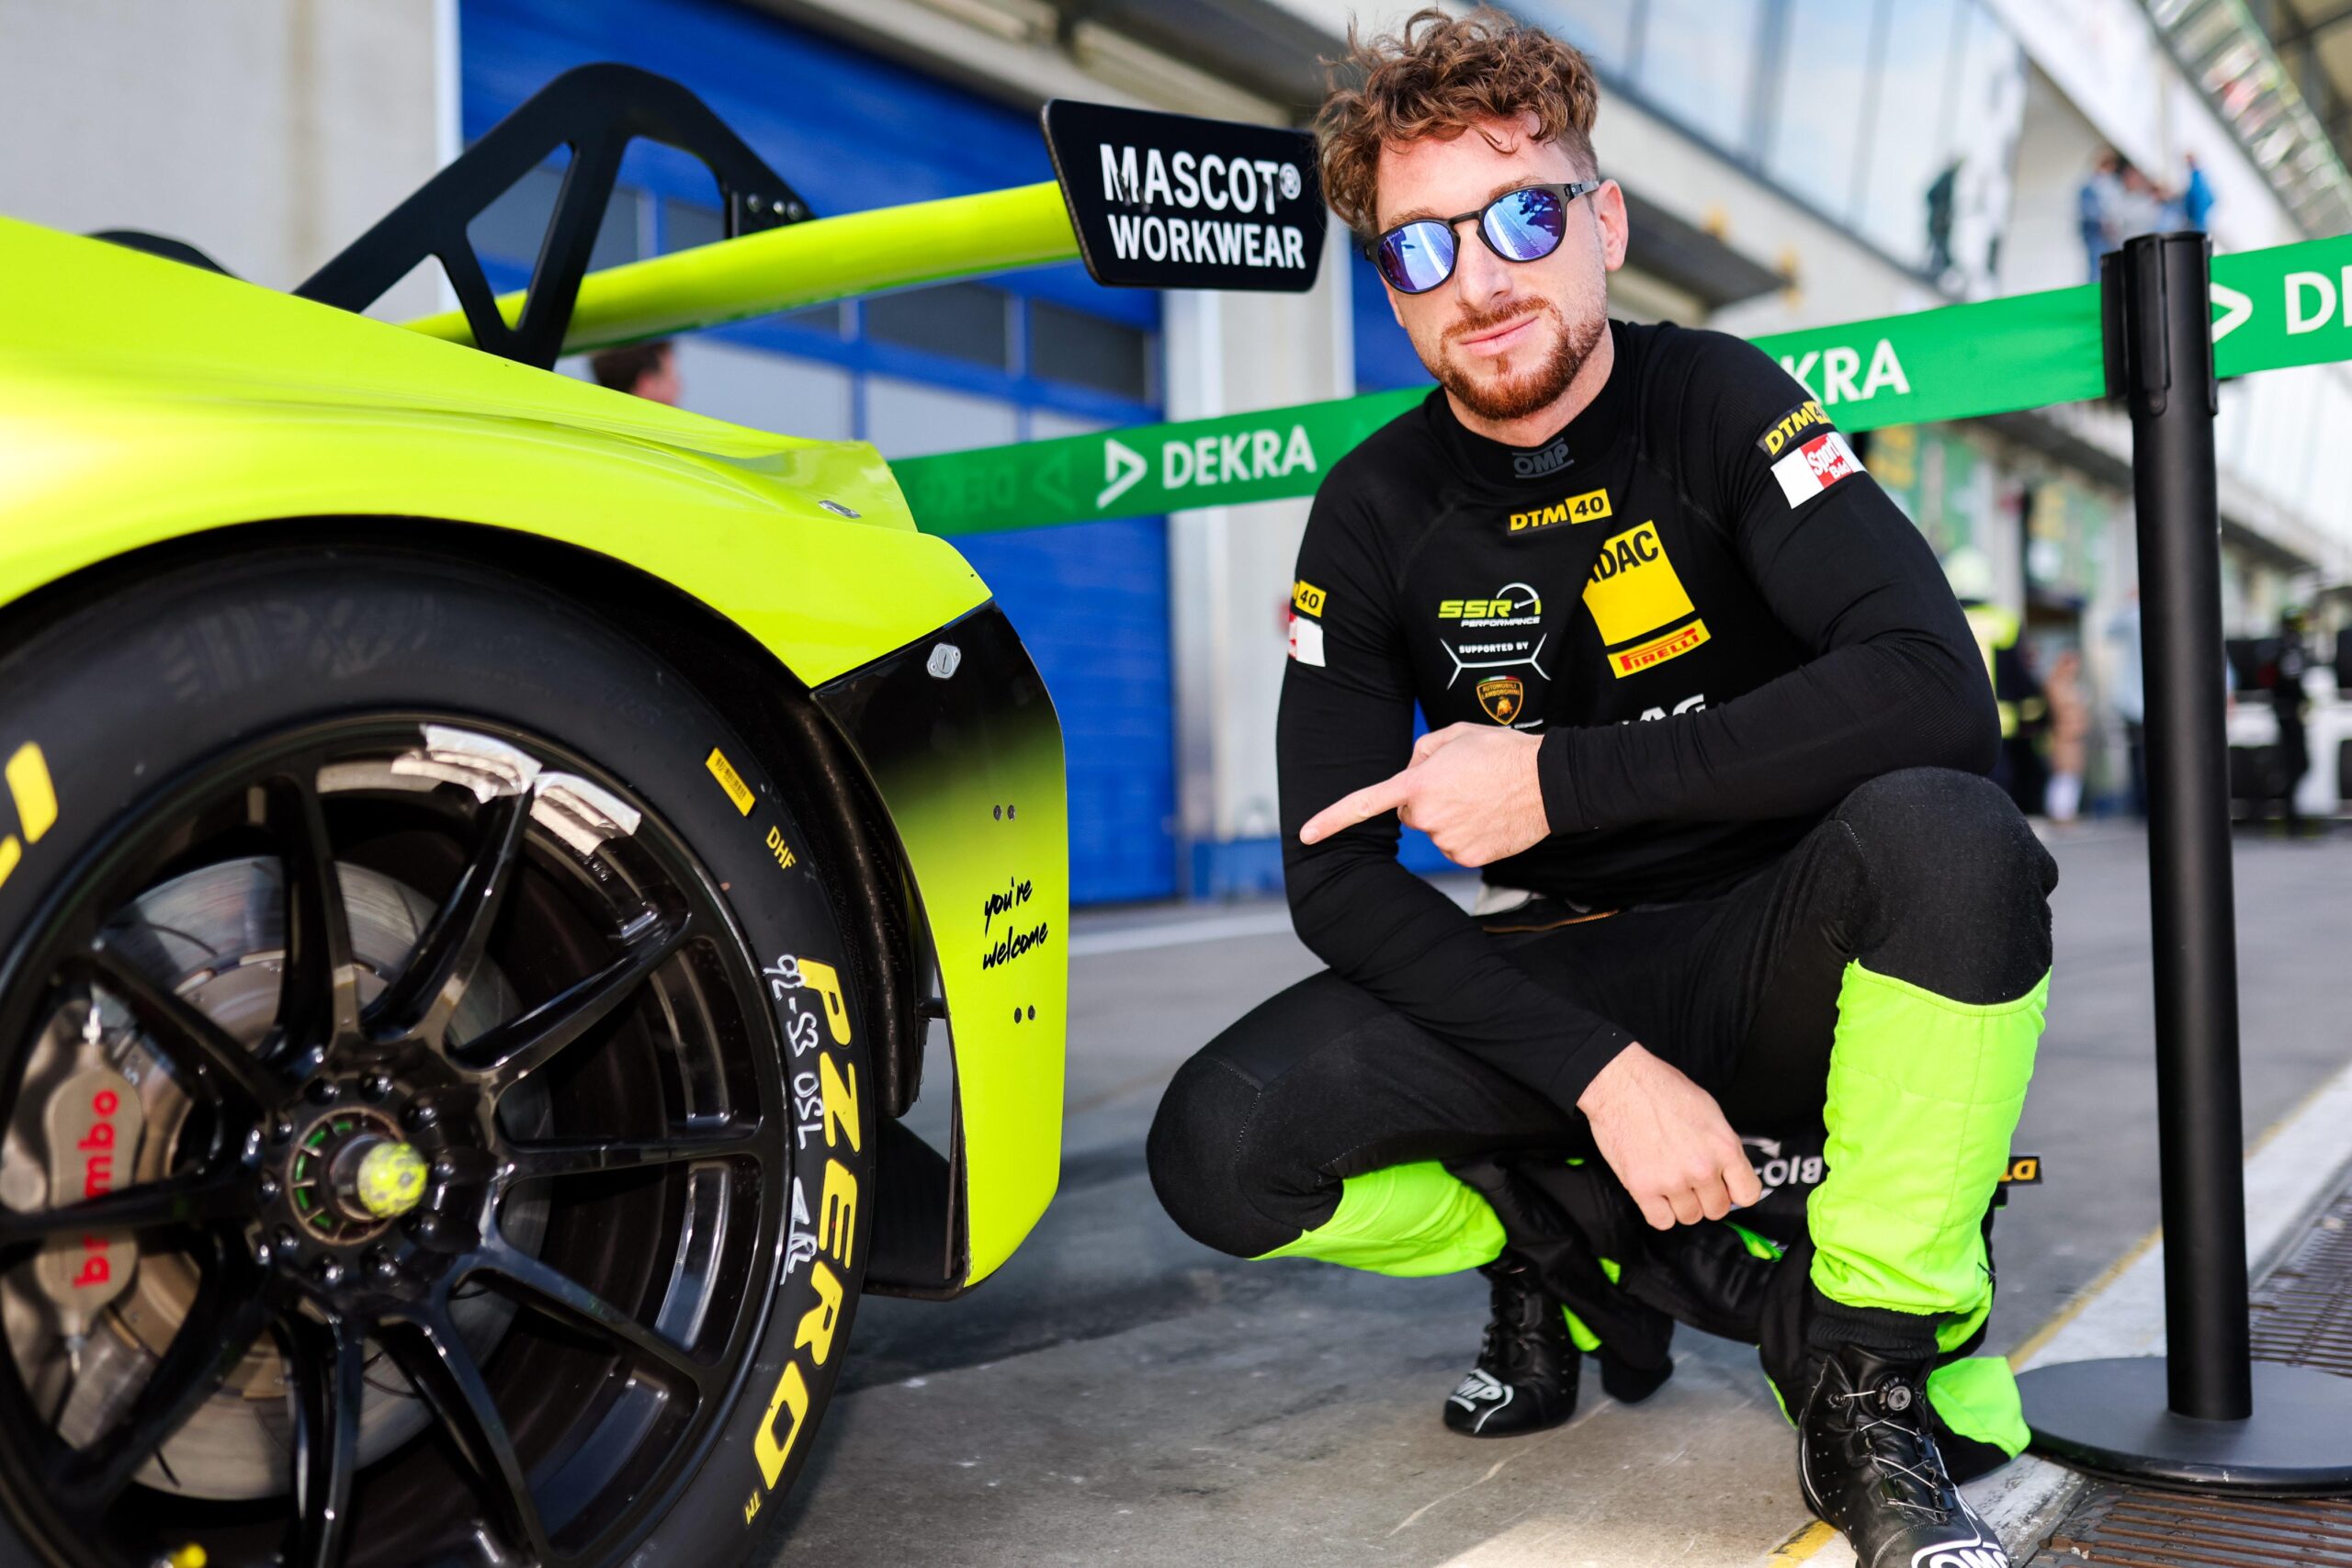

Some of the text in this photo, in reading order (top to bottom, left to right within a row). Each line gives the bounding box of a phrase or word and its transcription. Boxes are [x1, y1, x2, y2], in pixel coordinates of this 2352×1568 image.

[1107, 214, 1306, 269] WORKWEAR
[2284, 264, 2352, 336] D
[1765, 408, 1815, 456] DTM
[1162, 424, 1317, 490] DEKRA
[1513, 443, 1569, 476] OMP
[1807, 435, 1841, 477] Sport
[1510, 496, 1604, 532] DTM 40
[1299, 590, 1319, 609] 40
[1438, 600, 1512, 619] SSR
[1461, 615, 1541, 627] PERFORMANCE
[1459, 641, 1529, 654] SUPPORTED BY
[1619, 627, 1701, 672] PIRELLI
[1482, 682, 1517, 693] AUTOMOBILI
[765, 825, 797, 869] DHF
[984, 875, 1033, 938] you're
[982, 921, 1048, 971] welcome
[74, 1089, 120, 1289] brmbo
